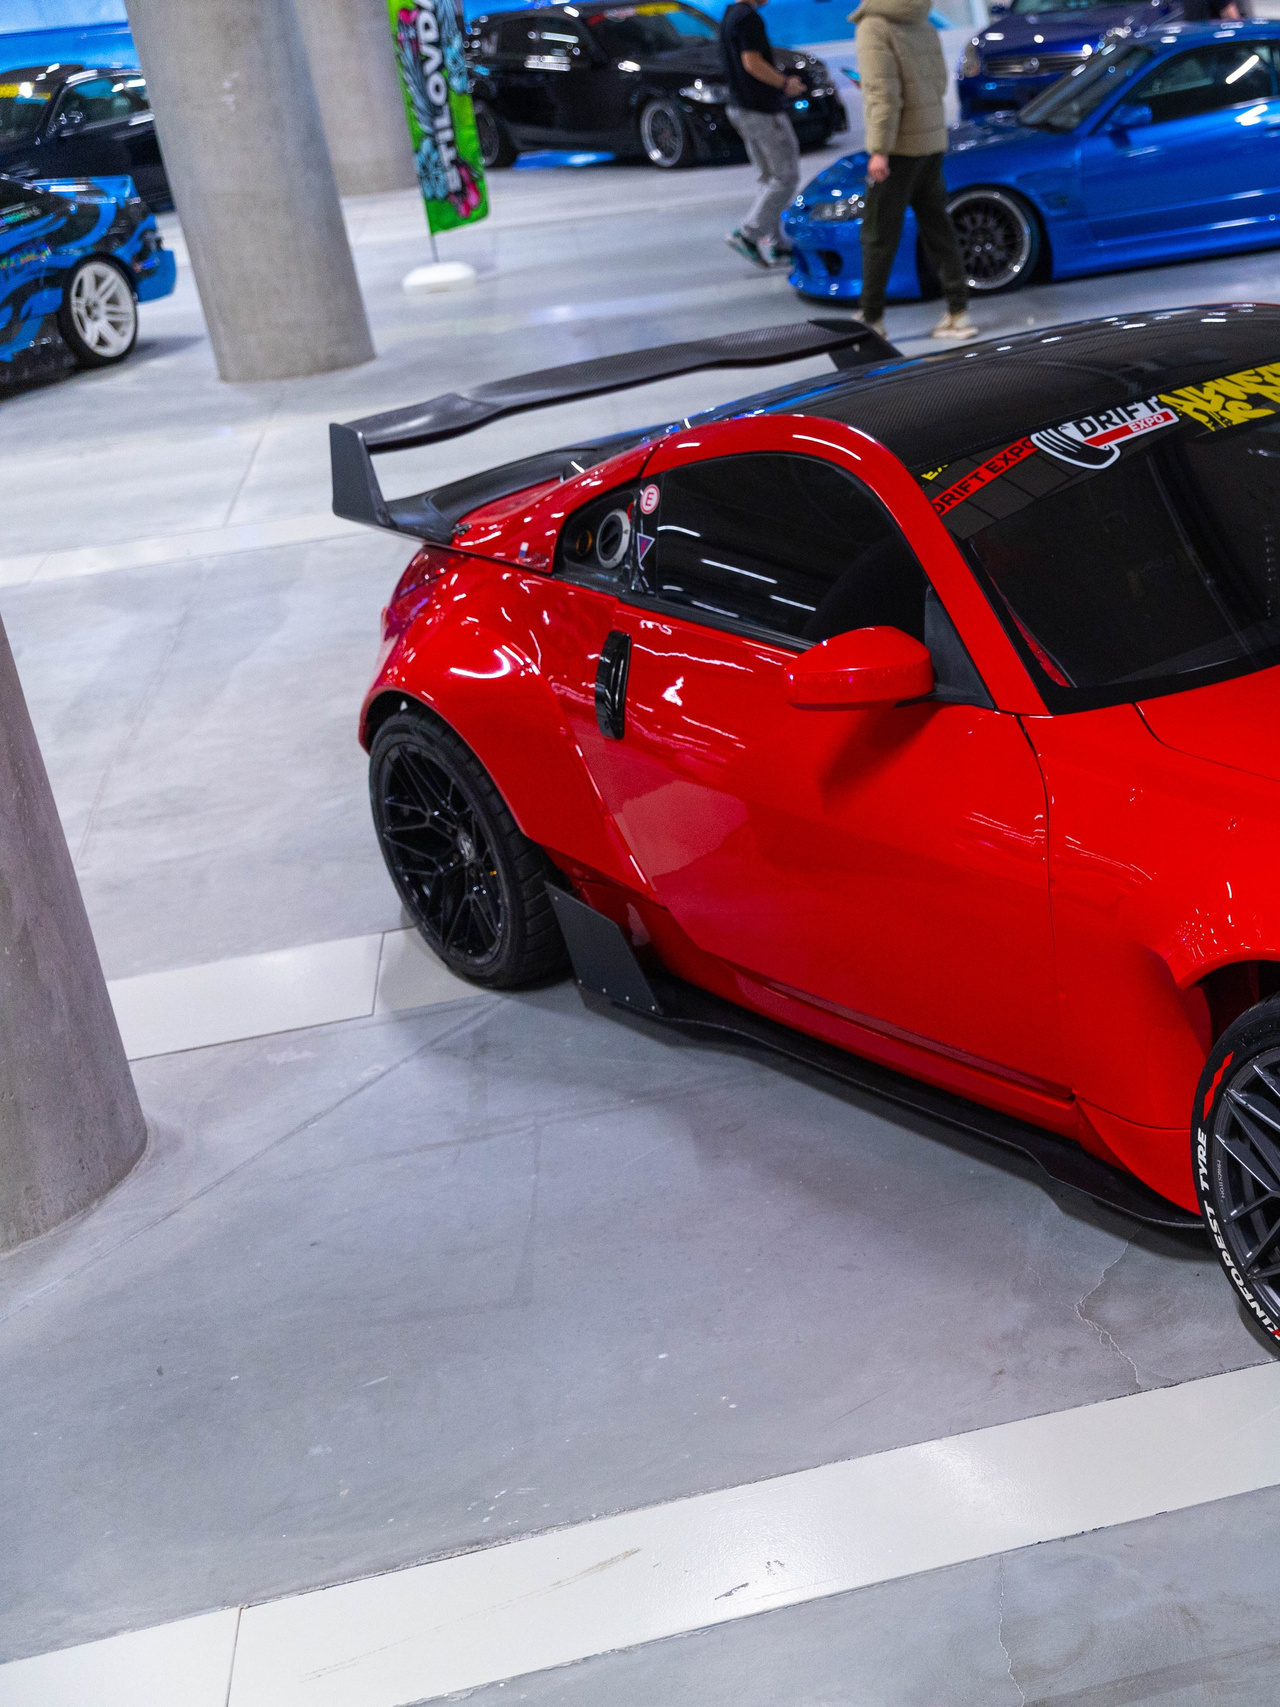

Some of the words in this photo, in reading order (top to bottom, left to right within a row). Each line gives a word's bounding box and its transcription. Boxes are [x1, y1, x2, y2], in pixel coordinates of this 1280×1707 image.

[1072, 396, 1158, 438] DRIFT
[1128, 414, 1165, 432] EXPO
[645, 491, 655, 507] E
[1197, 1127, 1209, 1191] TYRE
